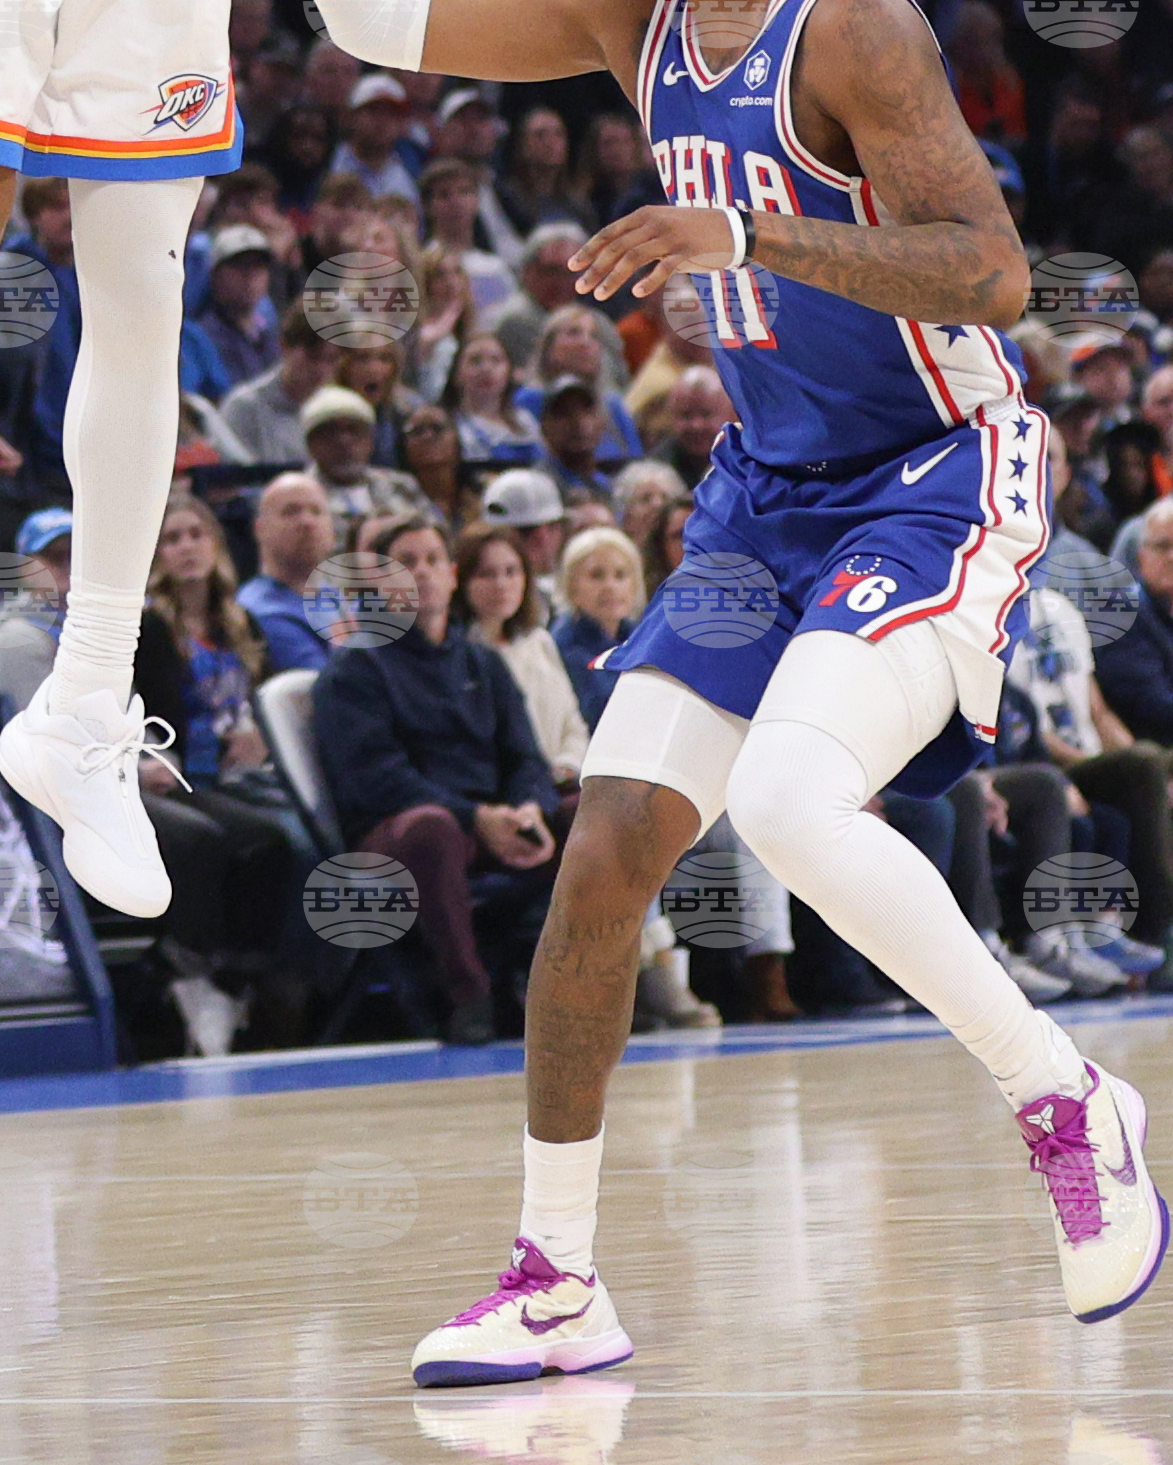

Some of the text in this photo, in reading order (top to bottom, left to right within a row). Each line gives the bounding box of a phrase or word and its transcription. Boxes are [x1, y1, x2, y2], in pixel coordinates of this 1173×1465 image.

[155, 83, 206, 124] OKC
[729, 95, 773, 109] crypto.com
[818, 570, 898, 613] 76
